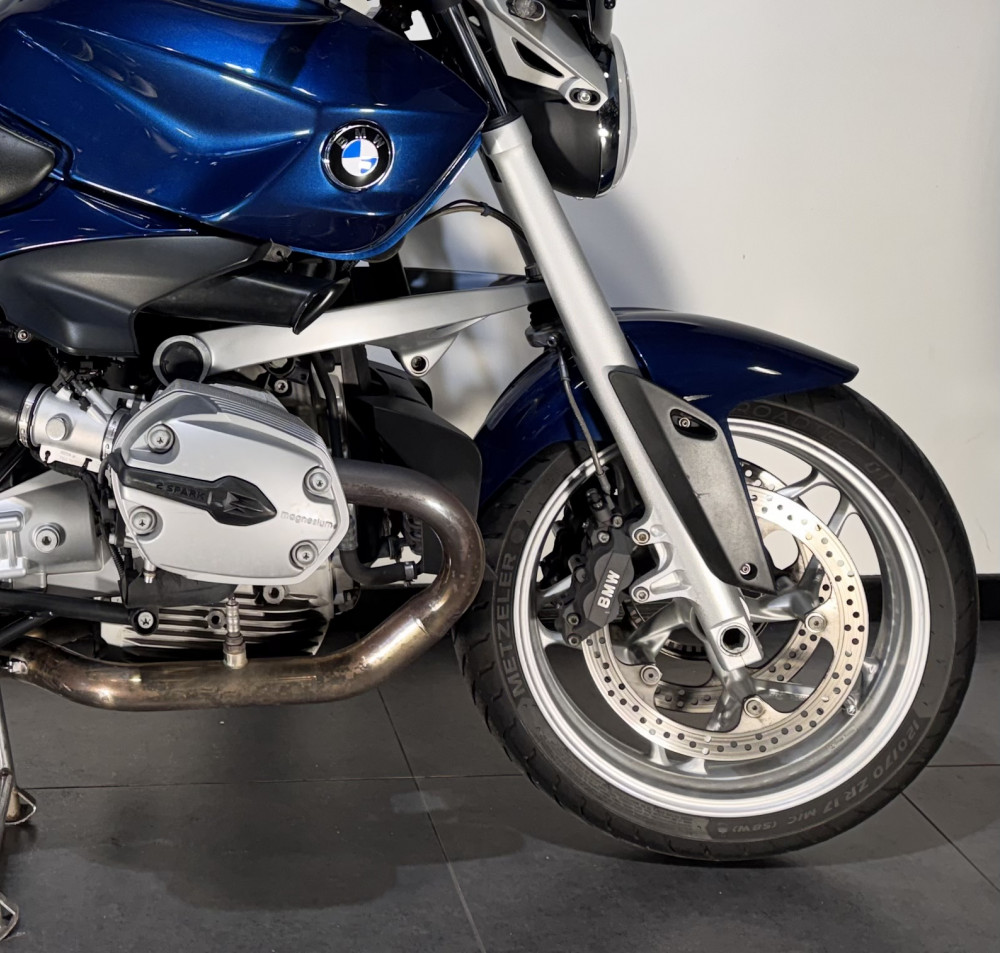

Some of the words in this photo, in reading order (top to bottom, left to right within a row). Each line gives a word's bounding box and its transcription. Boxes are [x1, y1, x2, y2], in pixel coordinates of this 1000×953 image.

[336, 128, 386, 149] BMW
[167, 485, 207, 501] SPARK
[280, 511, 333, 530] magnesium
[597, 569, 620, 609] BMW
[496, 552, 526, 697] METZELER
[844, 780, 870, 800] ZR
[823, 800, 840, 814] 17
